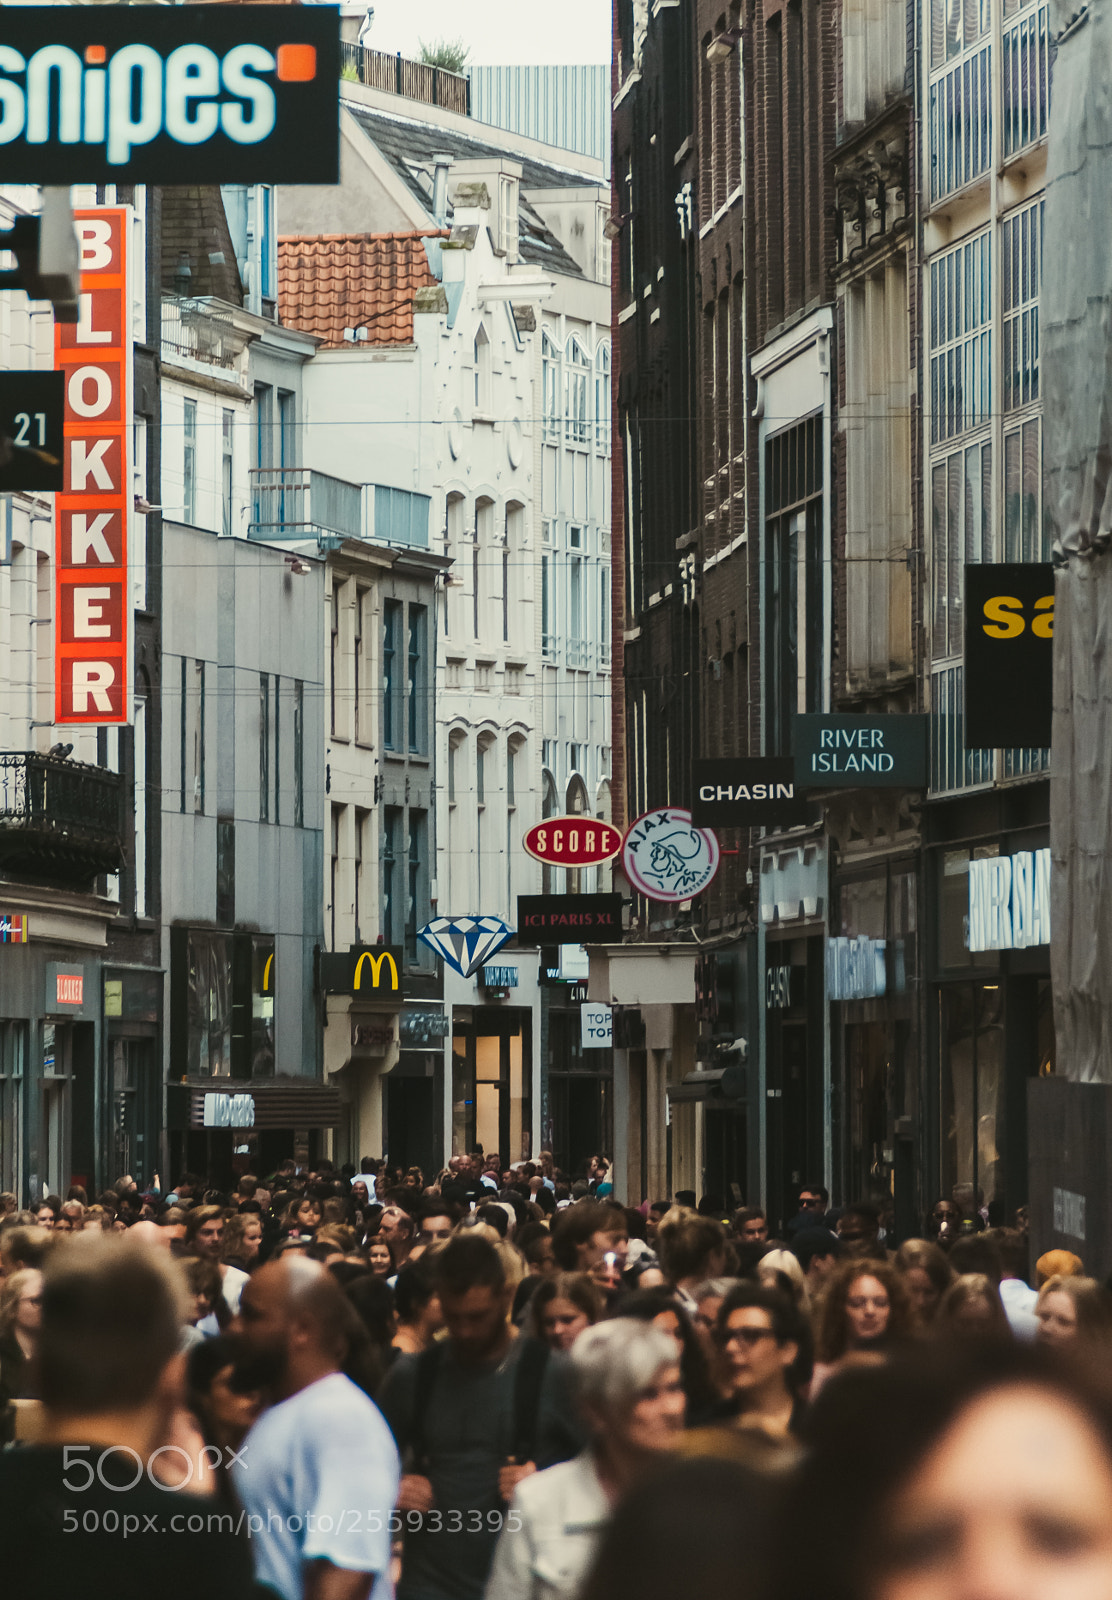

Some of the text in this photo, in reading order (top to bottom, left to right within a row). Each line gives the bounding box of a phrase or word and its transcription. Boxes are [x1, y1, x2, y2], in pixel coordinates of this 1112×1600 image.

[14, 412, 46, 447] 21
[67, 218, 116, 713] BLOKKER
[820, 729, 885, 749] RIVER
[811, 752, 895, 773] ISLAND
[699, 783, 794, 802] CHASIN
[536, 829, 611, 853] SCORE
[627, 811, 671, 852] AJAX
[678, 865, 713, 897] AMSTERDAM
[525, 912, 614, 927] ICI PARIS XL
[586, 1013, 612, 1025] TOP
